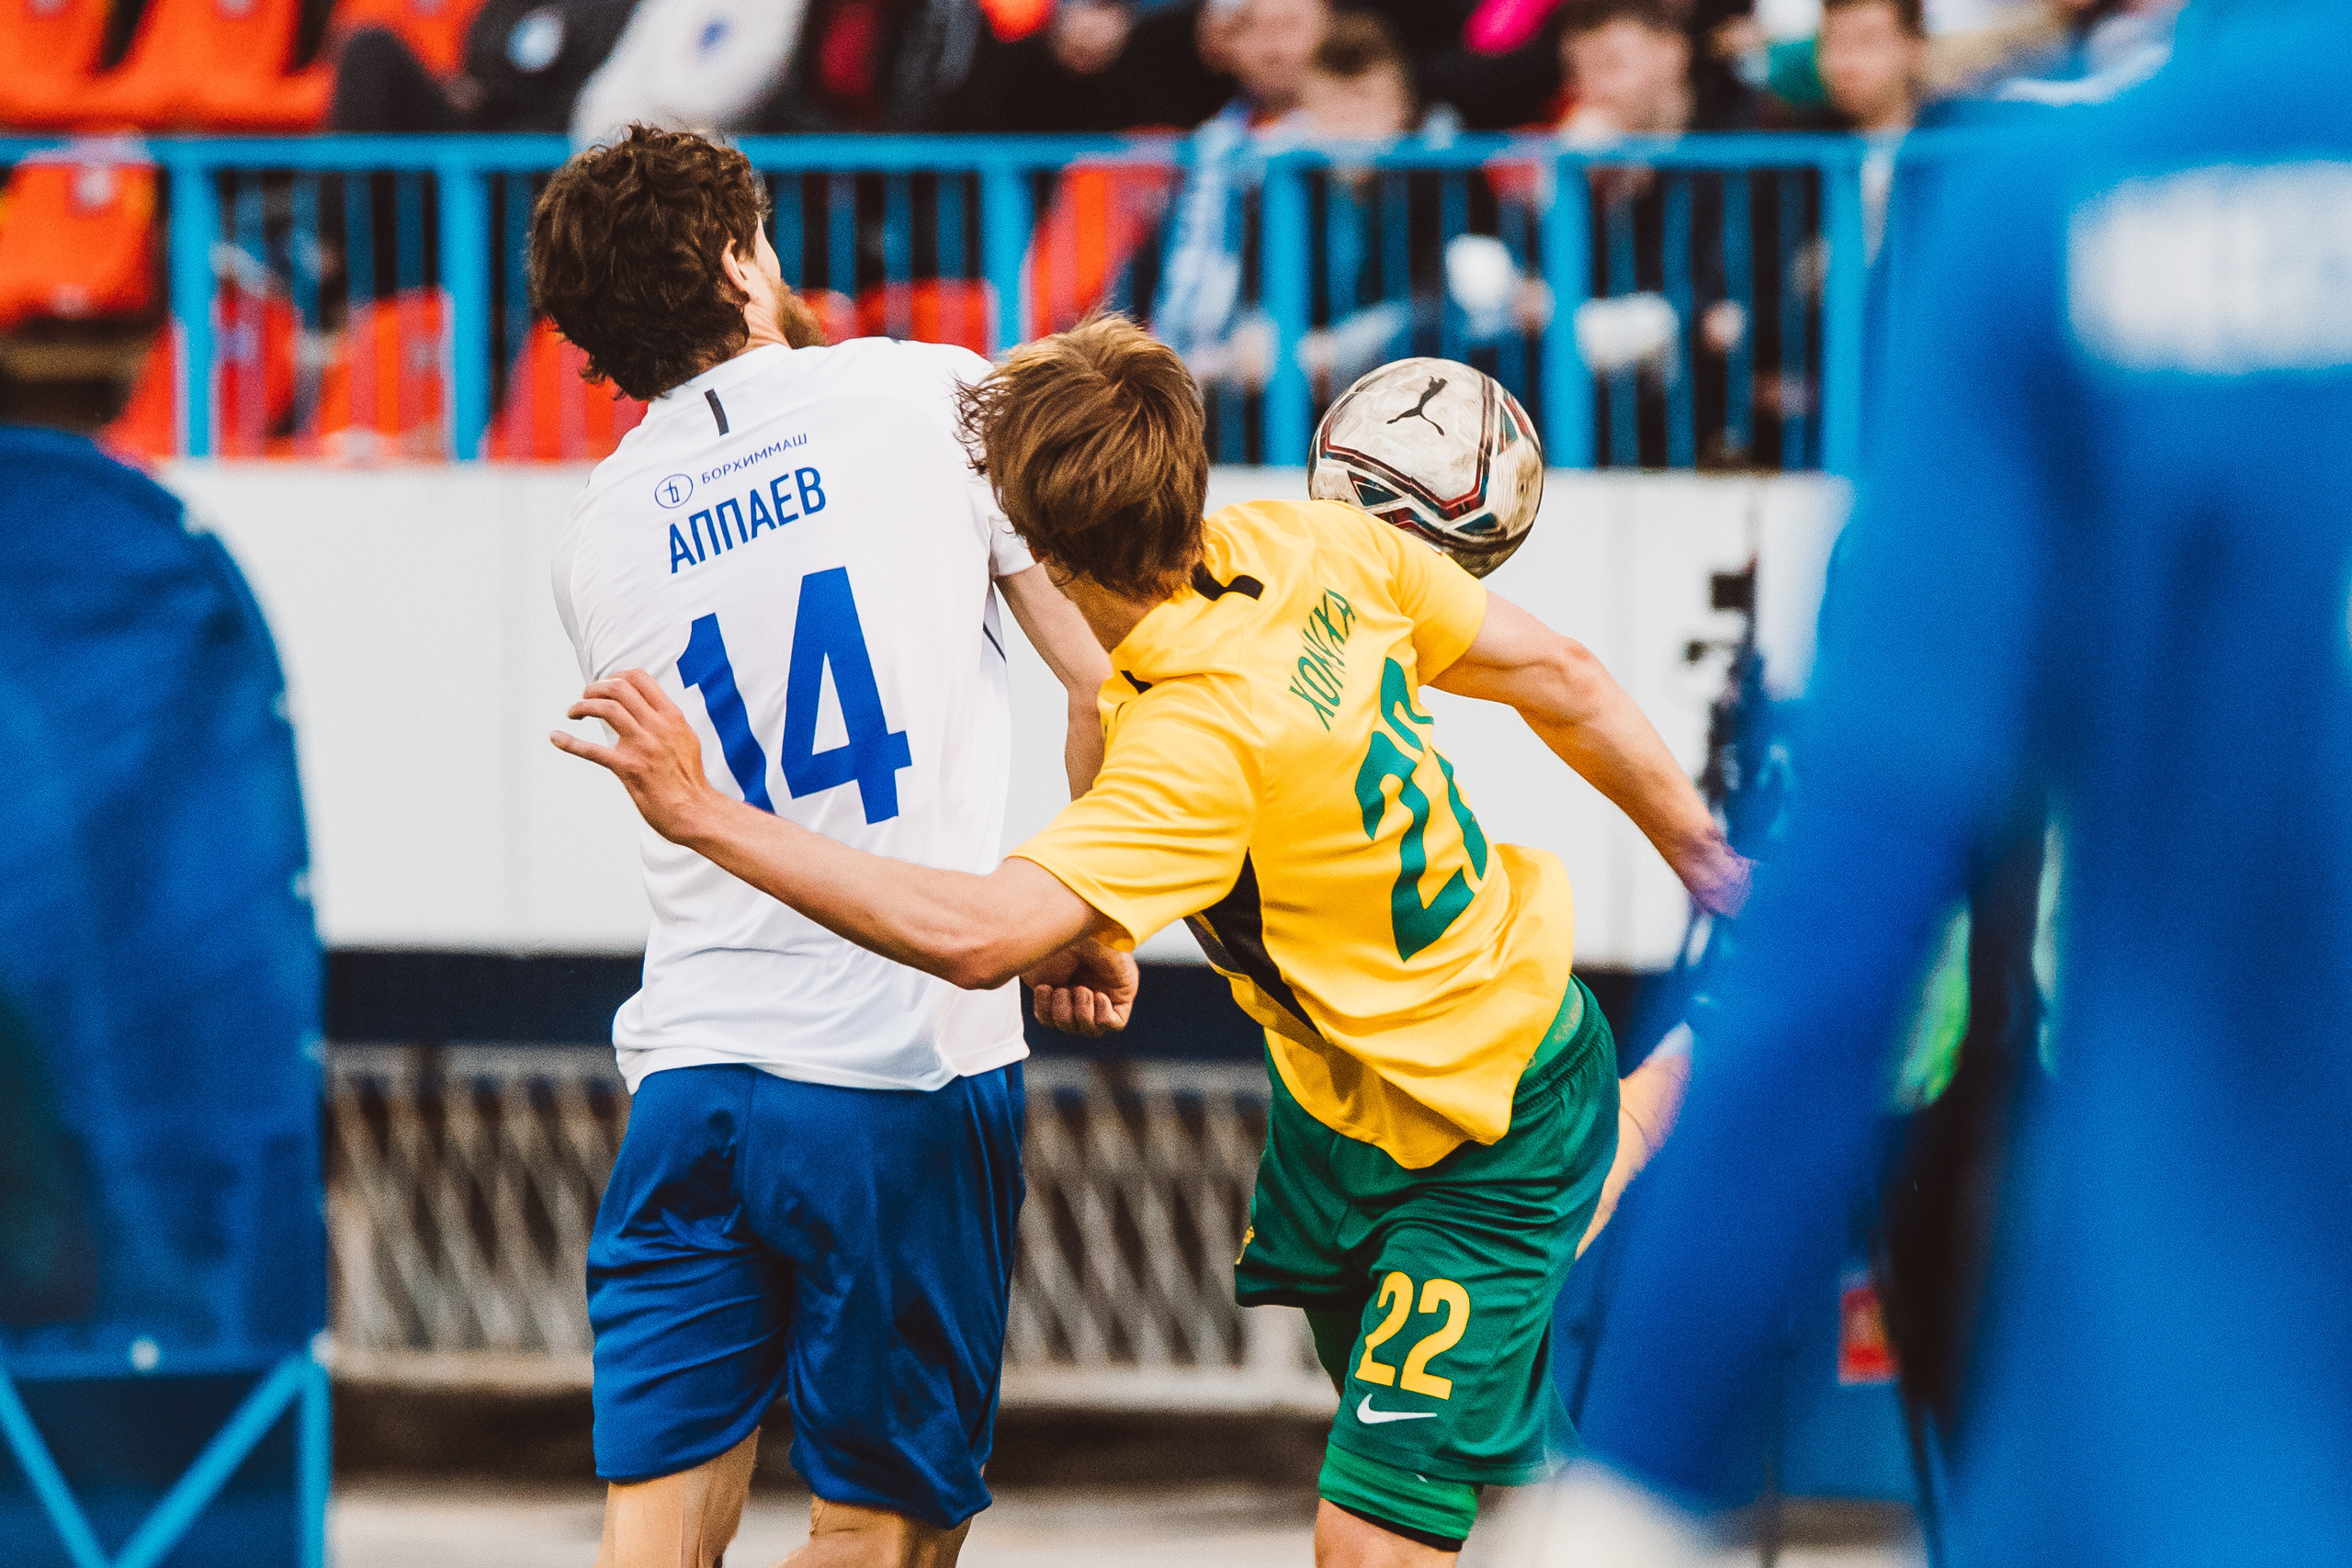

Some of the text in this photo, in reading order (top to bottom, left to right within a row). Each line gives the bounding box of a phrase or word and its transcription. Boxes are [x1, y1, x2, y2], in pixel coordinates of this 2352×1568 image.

[701, 433, 808, 484] БОРХИММАШ
[669, 467, 827, 574] АППАЕВ
[676, 566, 912, 825] 14
[1355, 1271, 1470, 1400] 22
